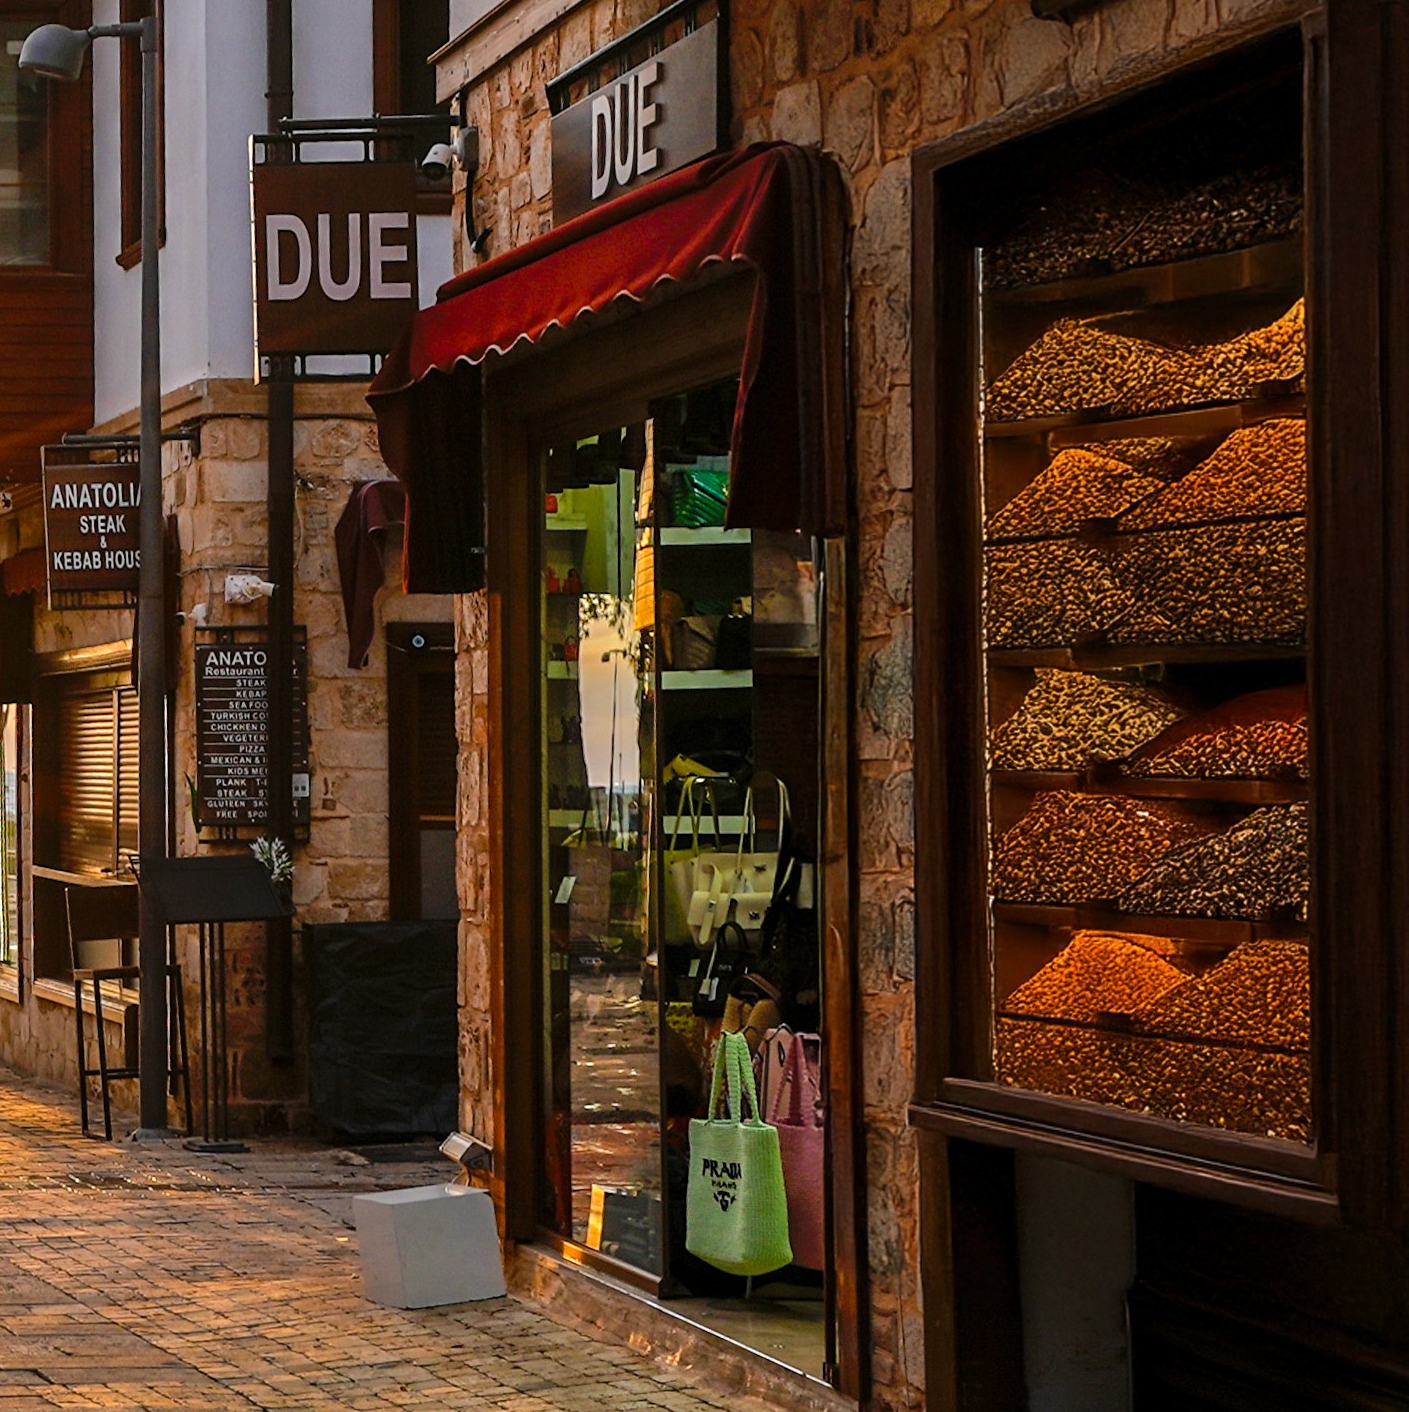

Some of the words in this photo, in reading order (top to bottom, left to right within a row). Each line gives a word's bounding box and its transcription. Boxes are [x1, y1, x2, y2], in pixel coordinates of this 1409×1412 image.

[591, 61, 660, 201] DUE
[265, 211, 412, 302] DUE
[79, 514, 127, 534] STEAK
[99, 535, 108, 549] &
[53, 551, 102, 571] KEBAB
[105, 550, 141, 569] HOUS
[206, 650, 268, 666] ANATO
[205, 666, 265, 677] Restaurant
[236, 679, 267, 687] STEAK
[228, 700, 248, 709] SEA
[248, 700, 269, 709] FOO
[210, 712, 251, 720] TURKISH
[239, 745, 265, 753] PIZZA
[210, 756, 252, 764] MEXICAN
[227, 767, 249, 775] KIDS
[215, 778, 247, 786] PLANK
[217, 789, 247, 797] STEAK
